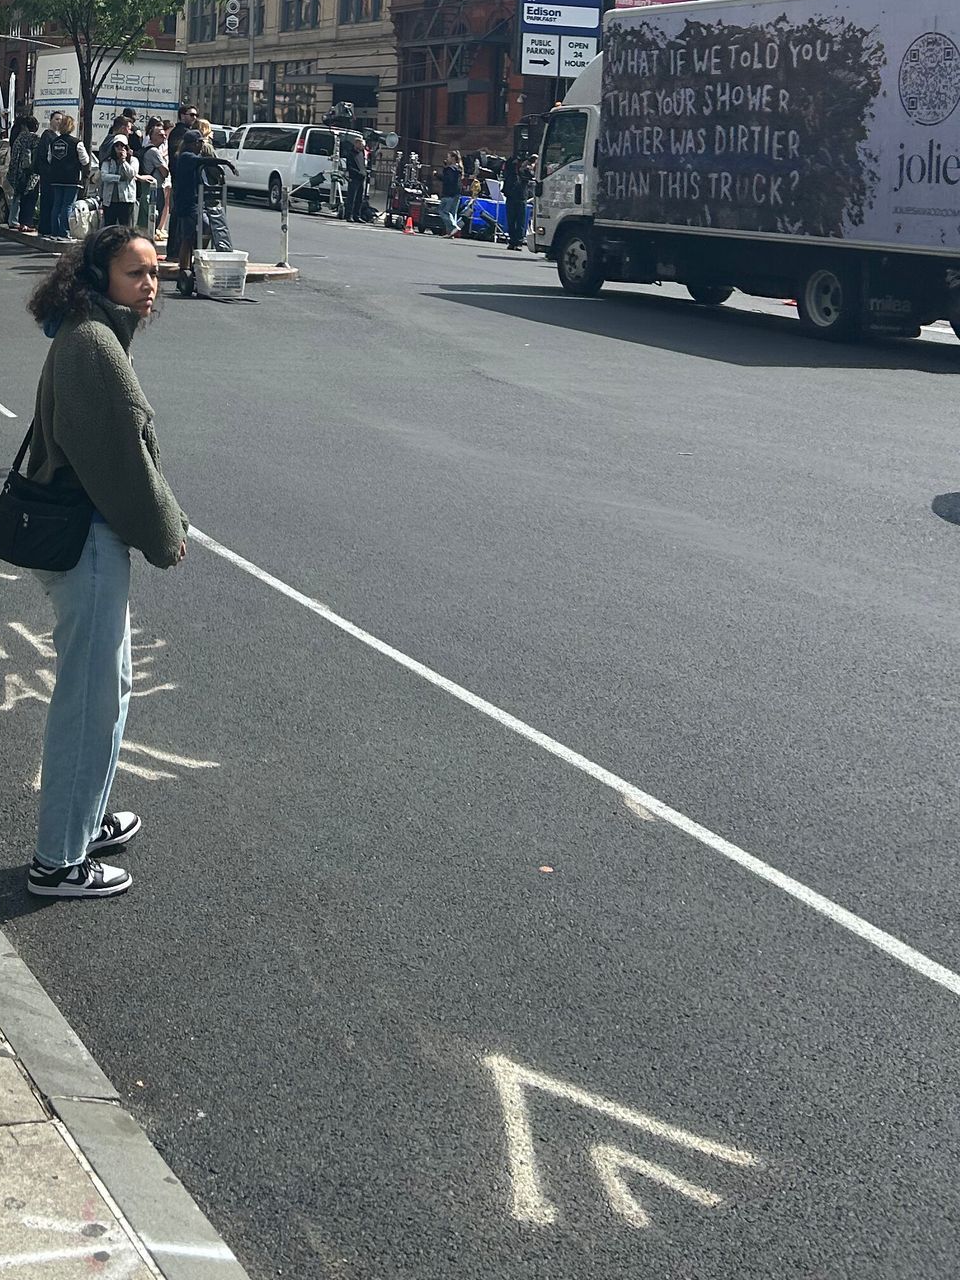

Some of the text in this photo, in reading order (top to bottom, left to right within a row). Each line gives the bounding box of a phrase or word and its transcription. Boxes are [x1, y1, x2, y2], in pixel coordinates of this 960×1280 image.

[526, 5, 562, 17] Edison
[526, 47, 556, 56] PARKING
[530, 38, 552, 47] PUBLIC
[568, 41, 589, 49] OPEN
[611, 49, 659, 76] WHAT
[670, 49, 687, 76] IF
[693, 45, 722, 75] WE
[791, 39, 830, 68] YOU
[605, 82, 790, 116] THAT YOUR SHOWER
[99, 112, 116, 120] 212
[605, 124, 800, 161] WATER WAS DIRTIER
[893, 138, 960, 192] jolie
[604, 171, 650, 199] THAN
[658, 170, 700, 200] THIS
